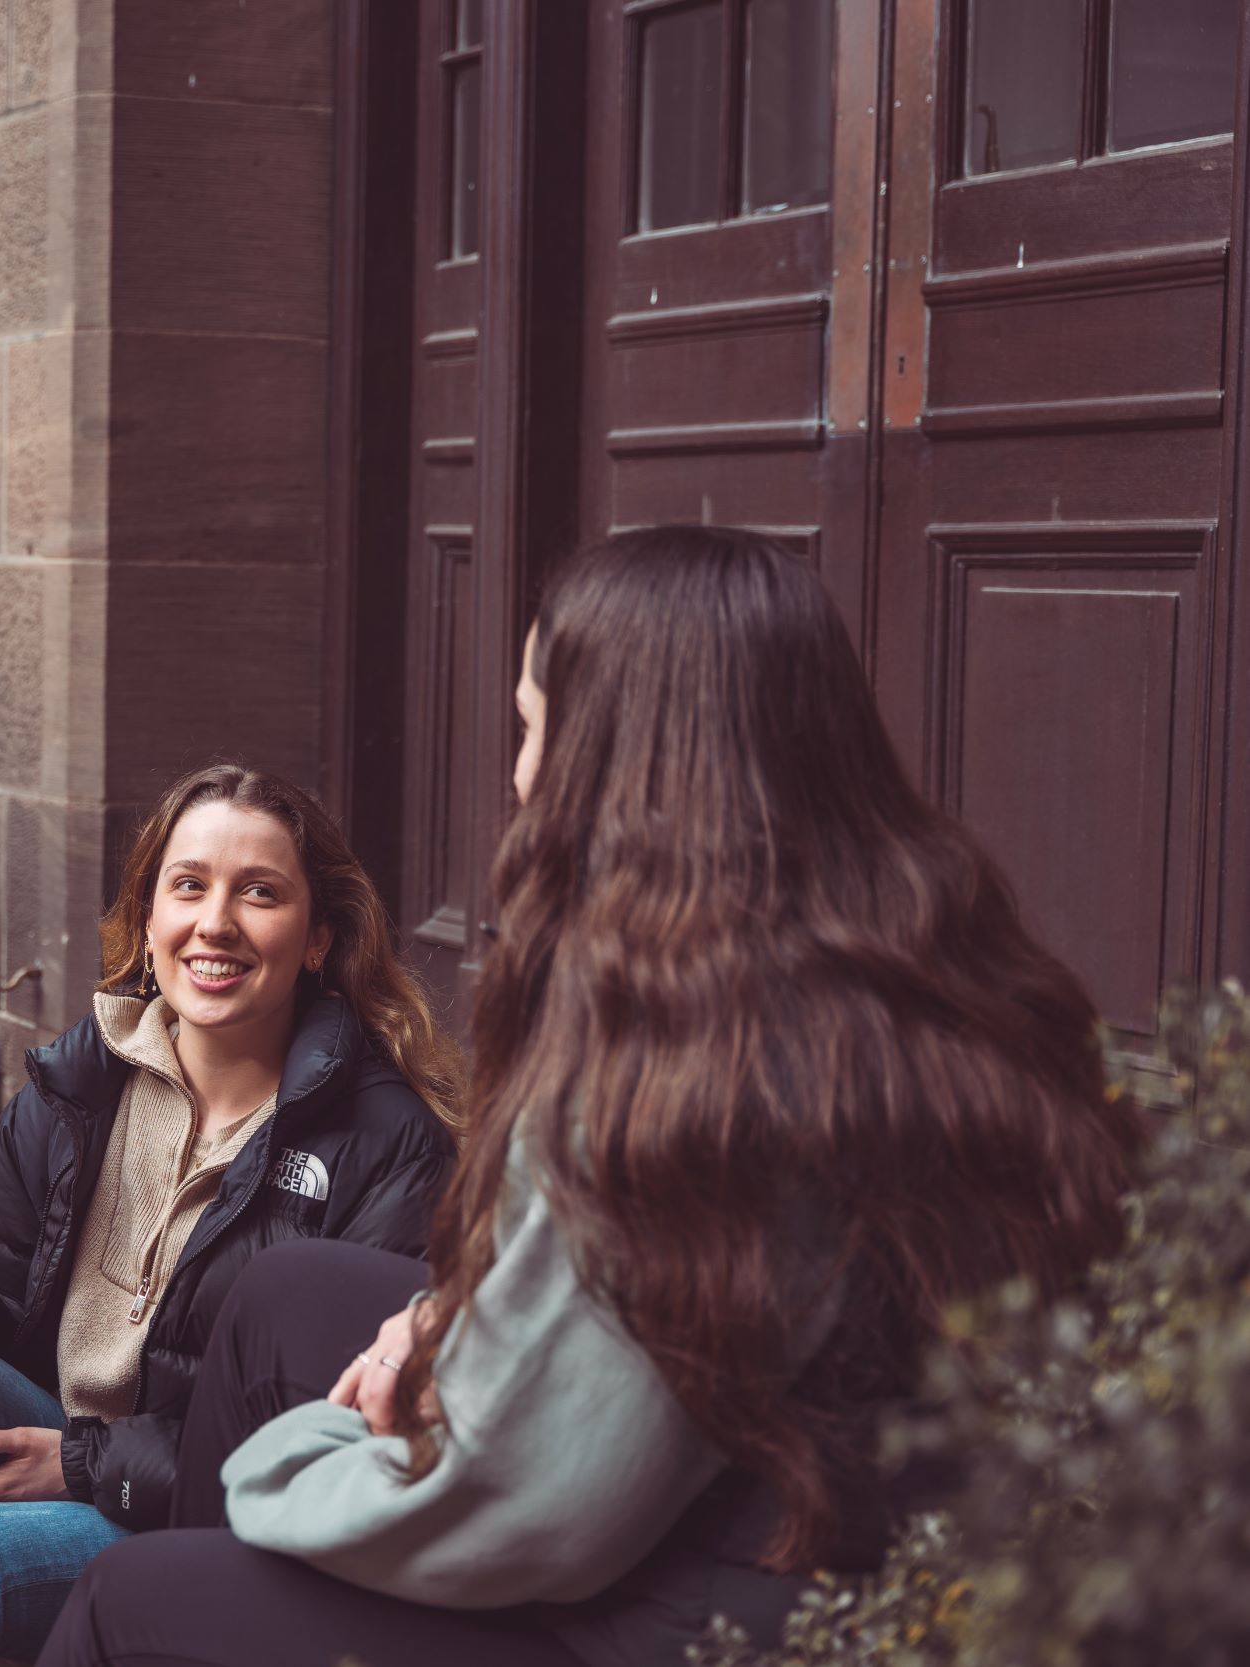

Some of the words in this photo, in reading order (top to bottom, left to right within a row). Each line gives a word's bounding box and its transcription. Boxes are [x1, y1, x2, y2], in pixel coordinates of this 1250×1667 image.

[281, 1147, 309, 1166] THE
[275, 1160, 304, 1179] RTH
[265, 1172, 300, 1193] FACE
[121, 1480, 130, 1510] 700
